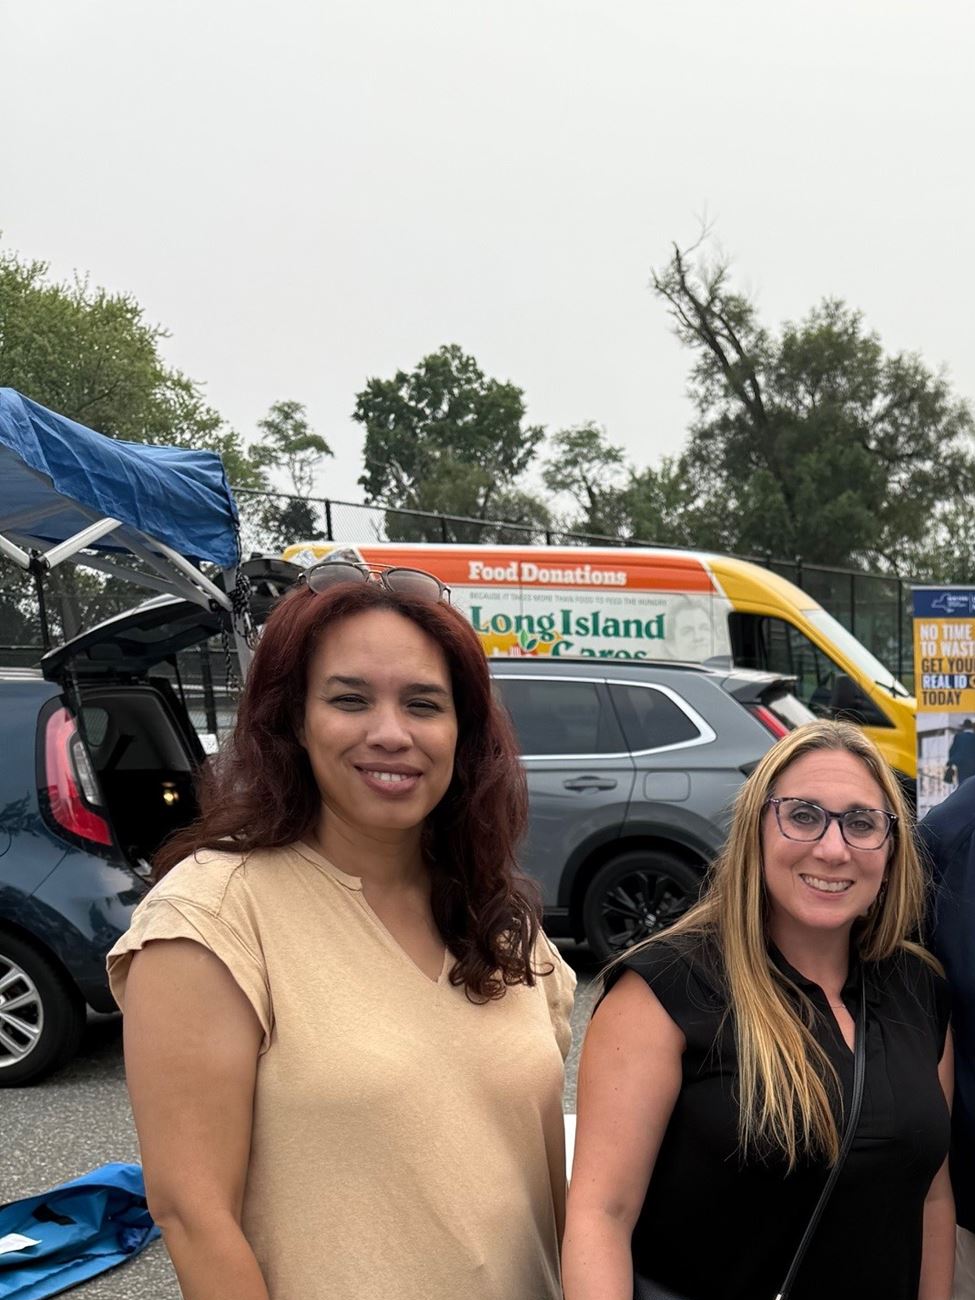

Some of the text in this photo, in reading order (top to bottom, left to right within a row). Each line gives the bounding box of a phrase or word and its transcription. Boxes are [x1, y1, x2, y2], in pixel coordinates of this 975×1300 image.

[468, 561, 627, 586] Food Donations
[470, 592, 500, 600] BECAUSE
[533, 594, 552, 602] MORE
[554, 595, 574, 603] THAN
[575, 596, 594, 604] FOOD
[605, 597, 623, 605] FEED
[624, 598, 637, 606] THE
[638, 599, 667, 607] HUNGRY
[469, 605, 666, 642] Long Island
[920, 624, 972, 640] NO TIME
[921, 641, 937, 657] TO
[921, 658, 944, 673] GET
[922, 675, 968, 689] REAL ID
[922, 691, 962, 706] TODAY
